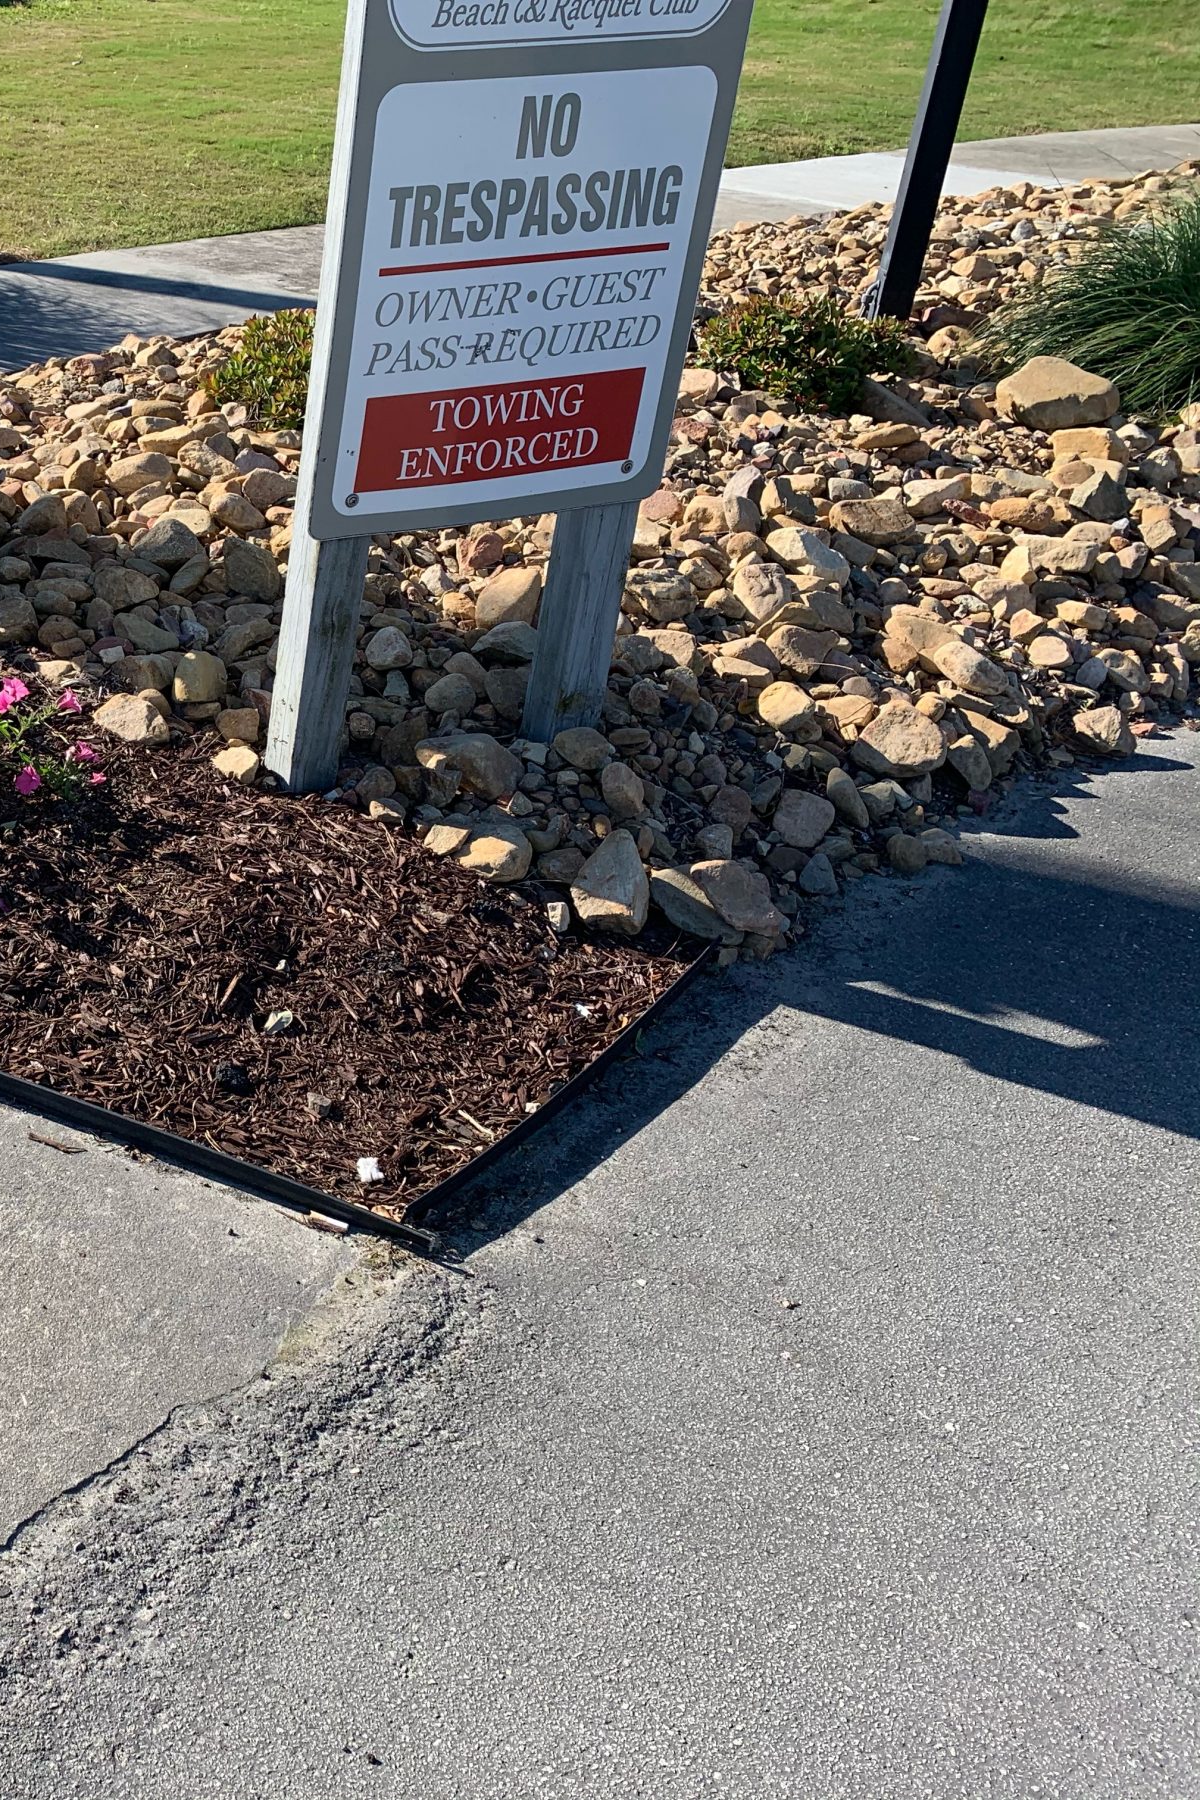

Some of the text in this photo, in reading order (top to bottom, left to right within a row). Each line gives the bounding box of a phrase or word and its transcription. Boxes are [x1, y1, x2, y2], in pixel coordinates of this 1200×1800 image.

[431, 0, 510, 28] Beach
[550, 0, 642, 30] Racquet
[515, 92, 582, 160] NO
[388, 164, 683, 249] TRESPASSING
[363, 314, 662, 377] PASS REQUIRED
[429, 383, 585, 433] TOWING
[396, 426, 600, 481] ENFORCED
